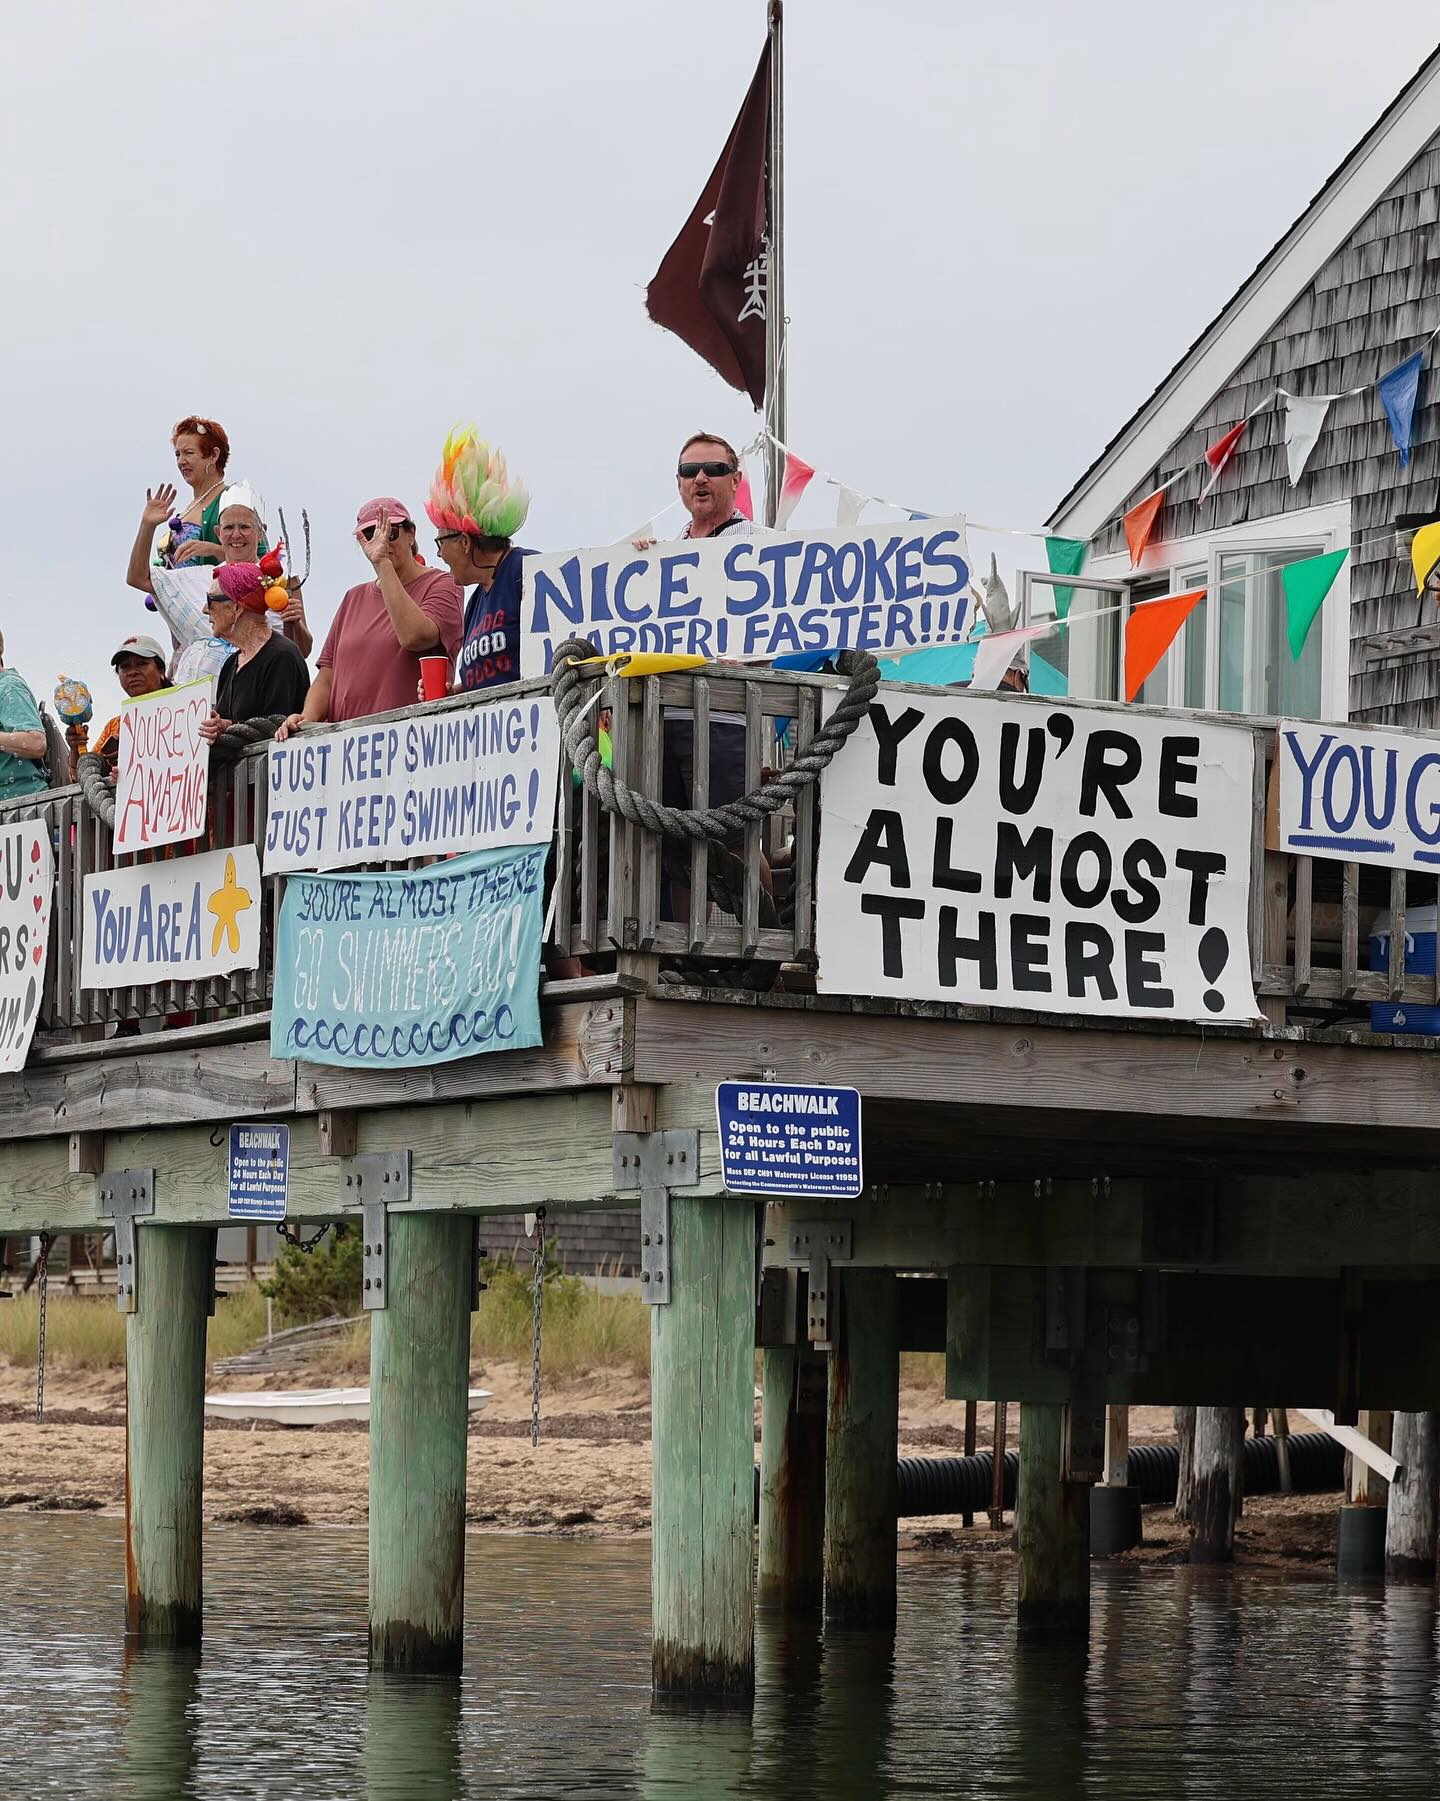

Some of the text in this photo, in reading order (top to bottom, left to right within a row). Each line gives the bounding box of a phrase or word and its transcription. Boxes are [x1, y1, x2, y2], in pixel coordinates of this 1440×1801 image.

[530, 530, 970, 633] NICE STROKES
[464, 631, 506, 666] GOOD
[743, 599, 968, 653] FASTER!!!
[272, 703, 540, 792] JUST KEEP SWIMMING!
[869, 703, 1200, 819] YOU'RE
[118, 763, 205, 842] AMAZING
[267, 768, 540, 857] JUST KEEP SWIMMING!
[1282, 731, 1399, 834] YOU
[368, 875, 465, 919] ALMOST
[467, 852, 542, 910] THERE
[844, 809, 1226, 925] ALMOST
[185, 882, 201, 960] A
[294, 903, 522, 1013] GO SWIMMERS GO!
[861, 893, 1229, 1013] THERE!
[729, 1120, 850, 1138] Open to the public
[738, 1092, 839, 1115] BEACHWALK
[234, 1156, 284, 1169] Open to the public
[239, 1132, 280, 1149] BEACHWALK
[725, 1148, 858, 1167] for all Lawful Purposes
[729, 1134, 851, 1153] 24 Hours Each Day
[230, 1181, 238, 1191] for
[247, 1182, 262, 1192] Lawful
[262, 1183, 286, 1193] Purposes
[233, 1169, 284, 1182] 24 Hours Each Day
[726, 1167, 742, 1175] Mass
[774, 1170, 808, 1180] Waterways
[810, 1172, 834, 1180] License
[835, 1173, 858, 1181] 11958
